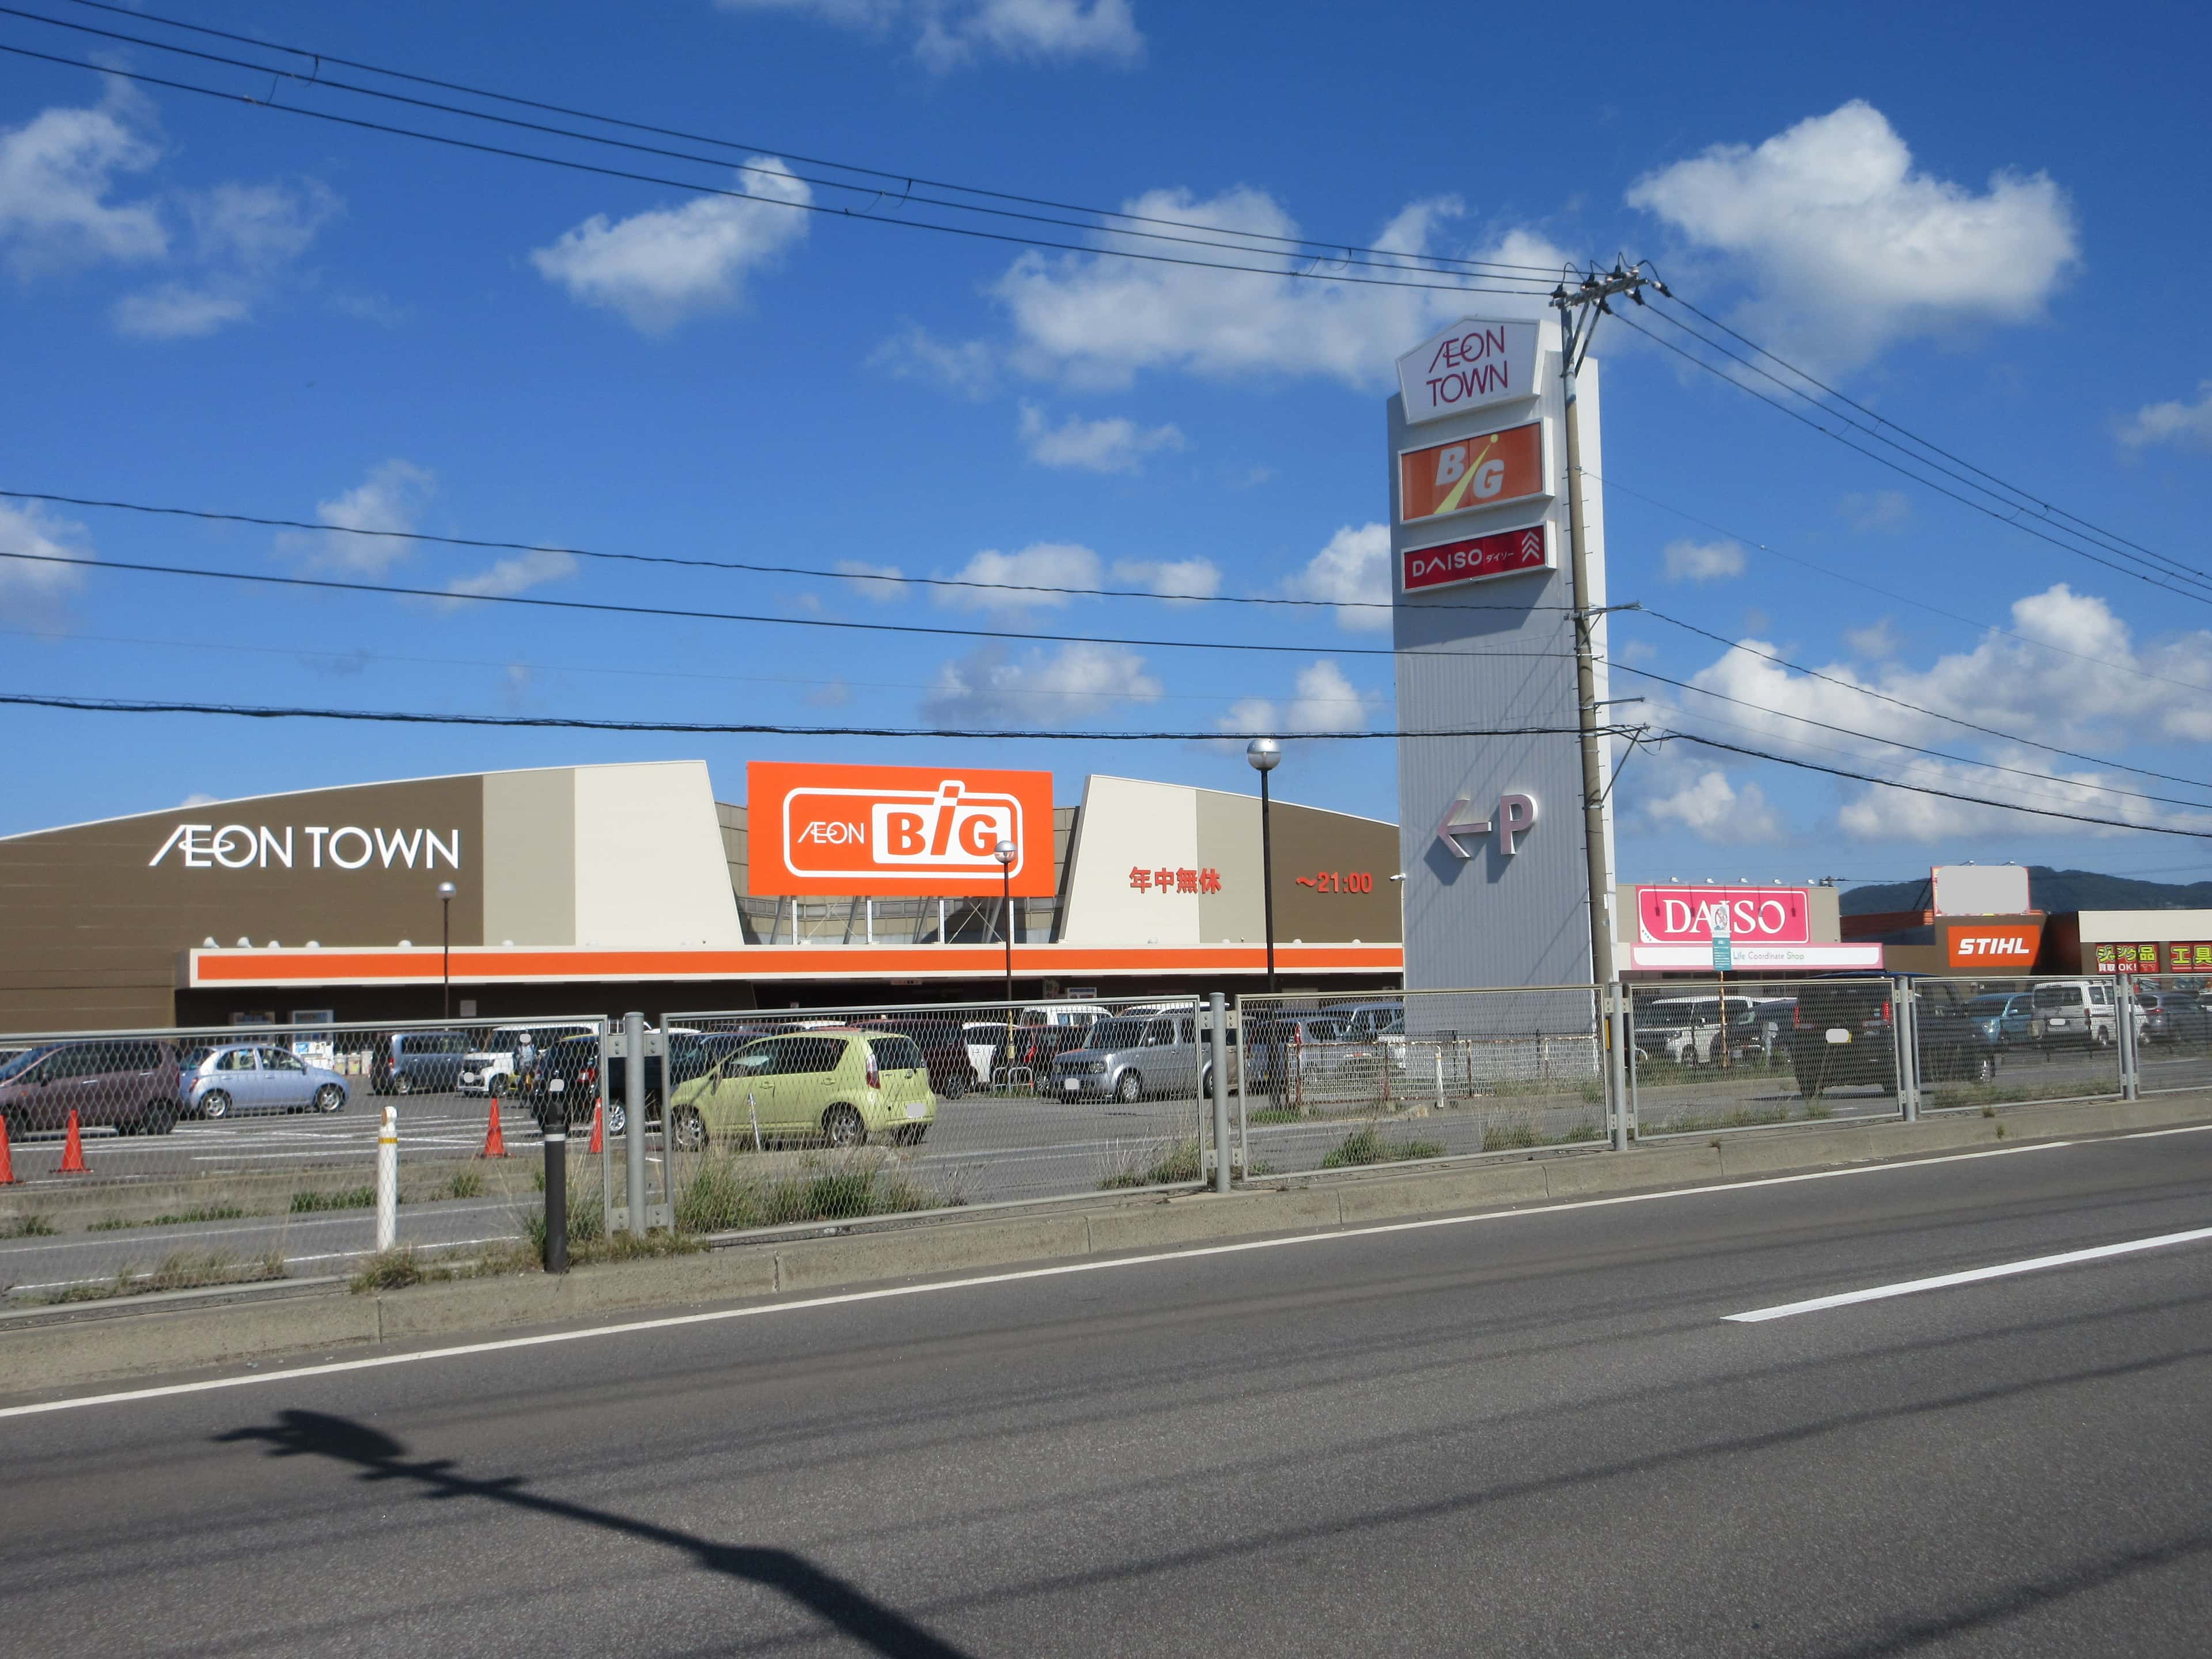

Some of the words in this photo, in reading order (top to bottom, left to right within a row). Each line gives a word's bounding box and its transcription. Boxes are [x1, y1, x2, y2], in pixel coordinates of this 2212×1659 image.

[1426, 361, 1508, 406] TOWN
[1413, 548, 1483, 577] DAISO
[1486, 552, 1514, 563] ダイソー
[1500, 793, 1538, 854] P
[305, 827, 460, 869] TOWN
[1130, 866, 1221, 893] 年中無休
[1748, 952, 1785, 960] Coordinate
[1787, 952, 1804, 960] Shop
[1957, 937, 2029, 955] STIHL
[2097, 945, 2156, 963] ジャンク品
[2118, 963, 2138, 971] OK!
